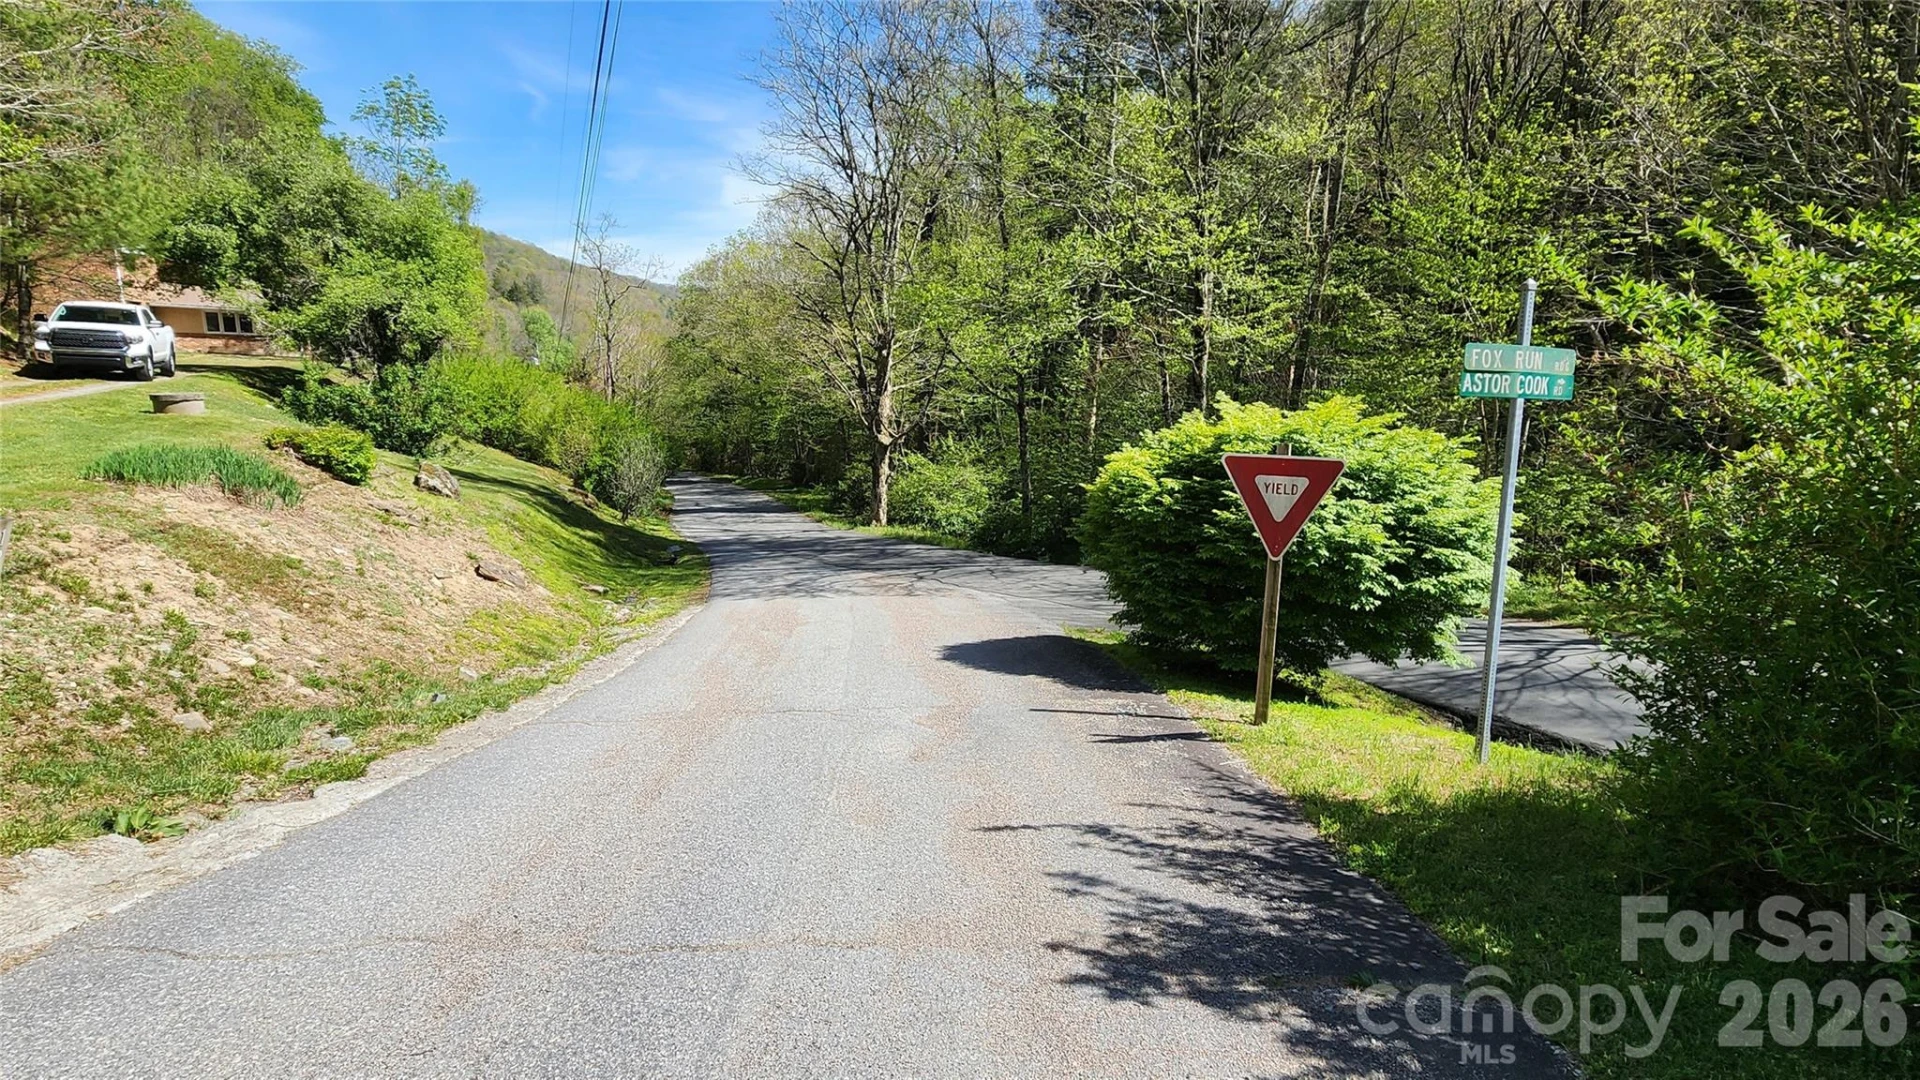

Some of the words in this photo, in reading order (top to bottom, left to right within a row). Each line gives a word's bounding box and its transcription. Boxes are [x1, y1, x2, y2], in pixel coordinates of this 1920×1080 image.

[1472, 349, 1503, 369] FOX
[1515, 350, 1544, 370] RUN
[1462, 372, 1511, 394] ASTOR
[1516, 375, 1550, 395] COOK
[1264, 482, 1299, 496] YIELD
